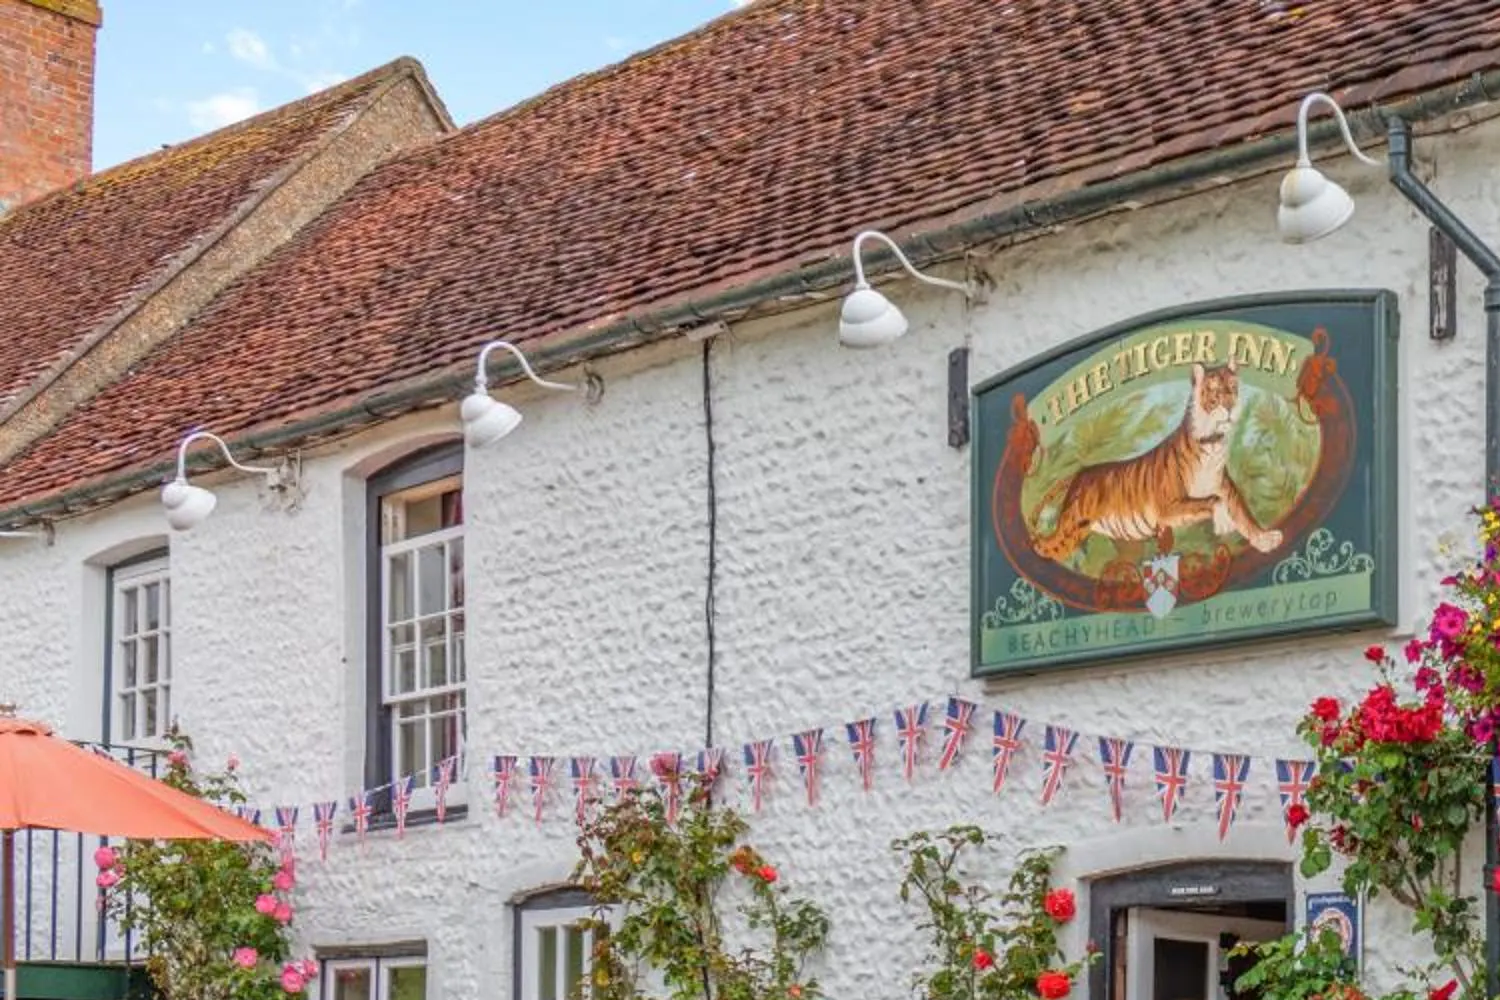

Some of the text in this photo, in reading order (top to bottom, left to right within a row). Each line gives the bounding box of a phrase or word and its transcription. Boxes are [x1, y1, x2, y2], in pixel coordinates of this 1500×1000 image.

[1047, 330, 1293, 425] THE TIGER INN
